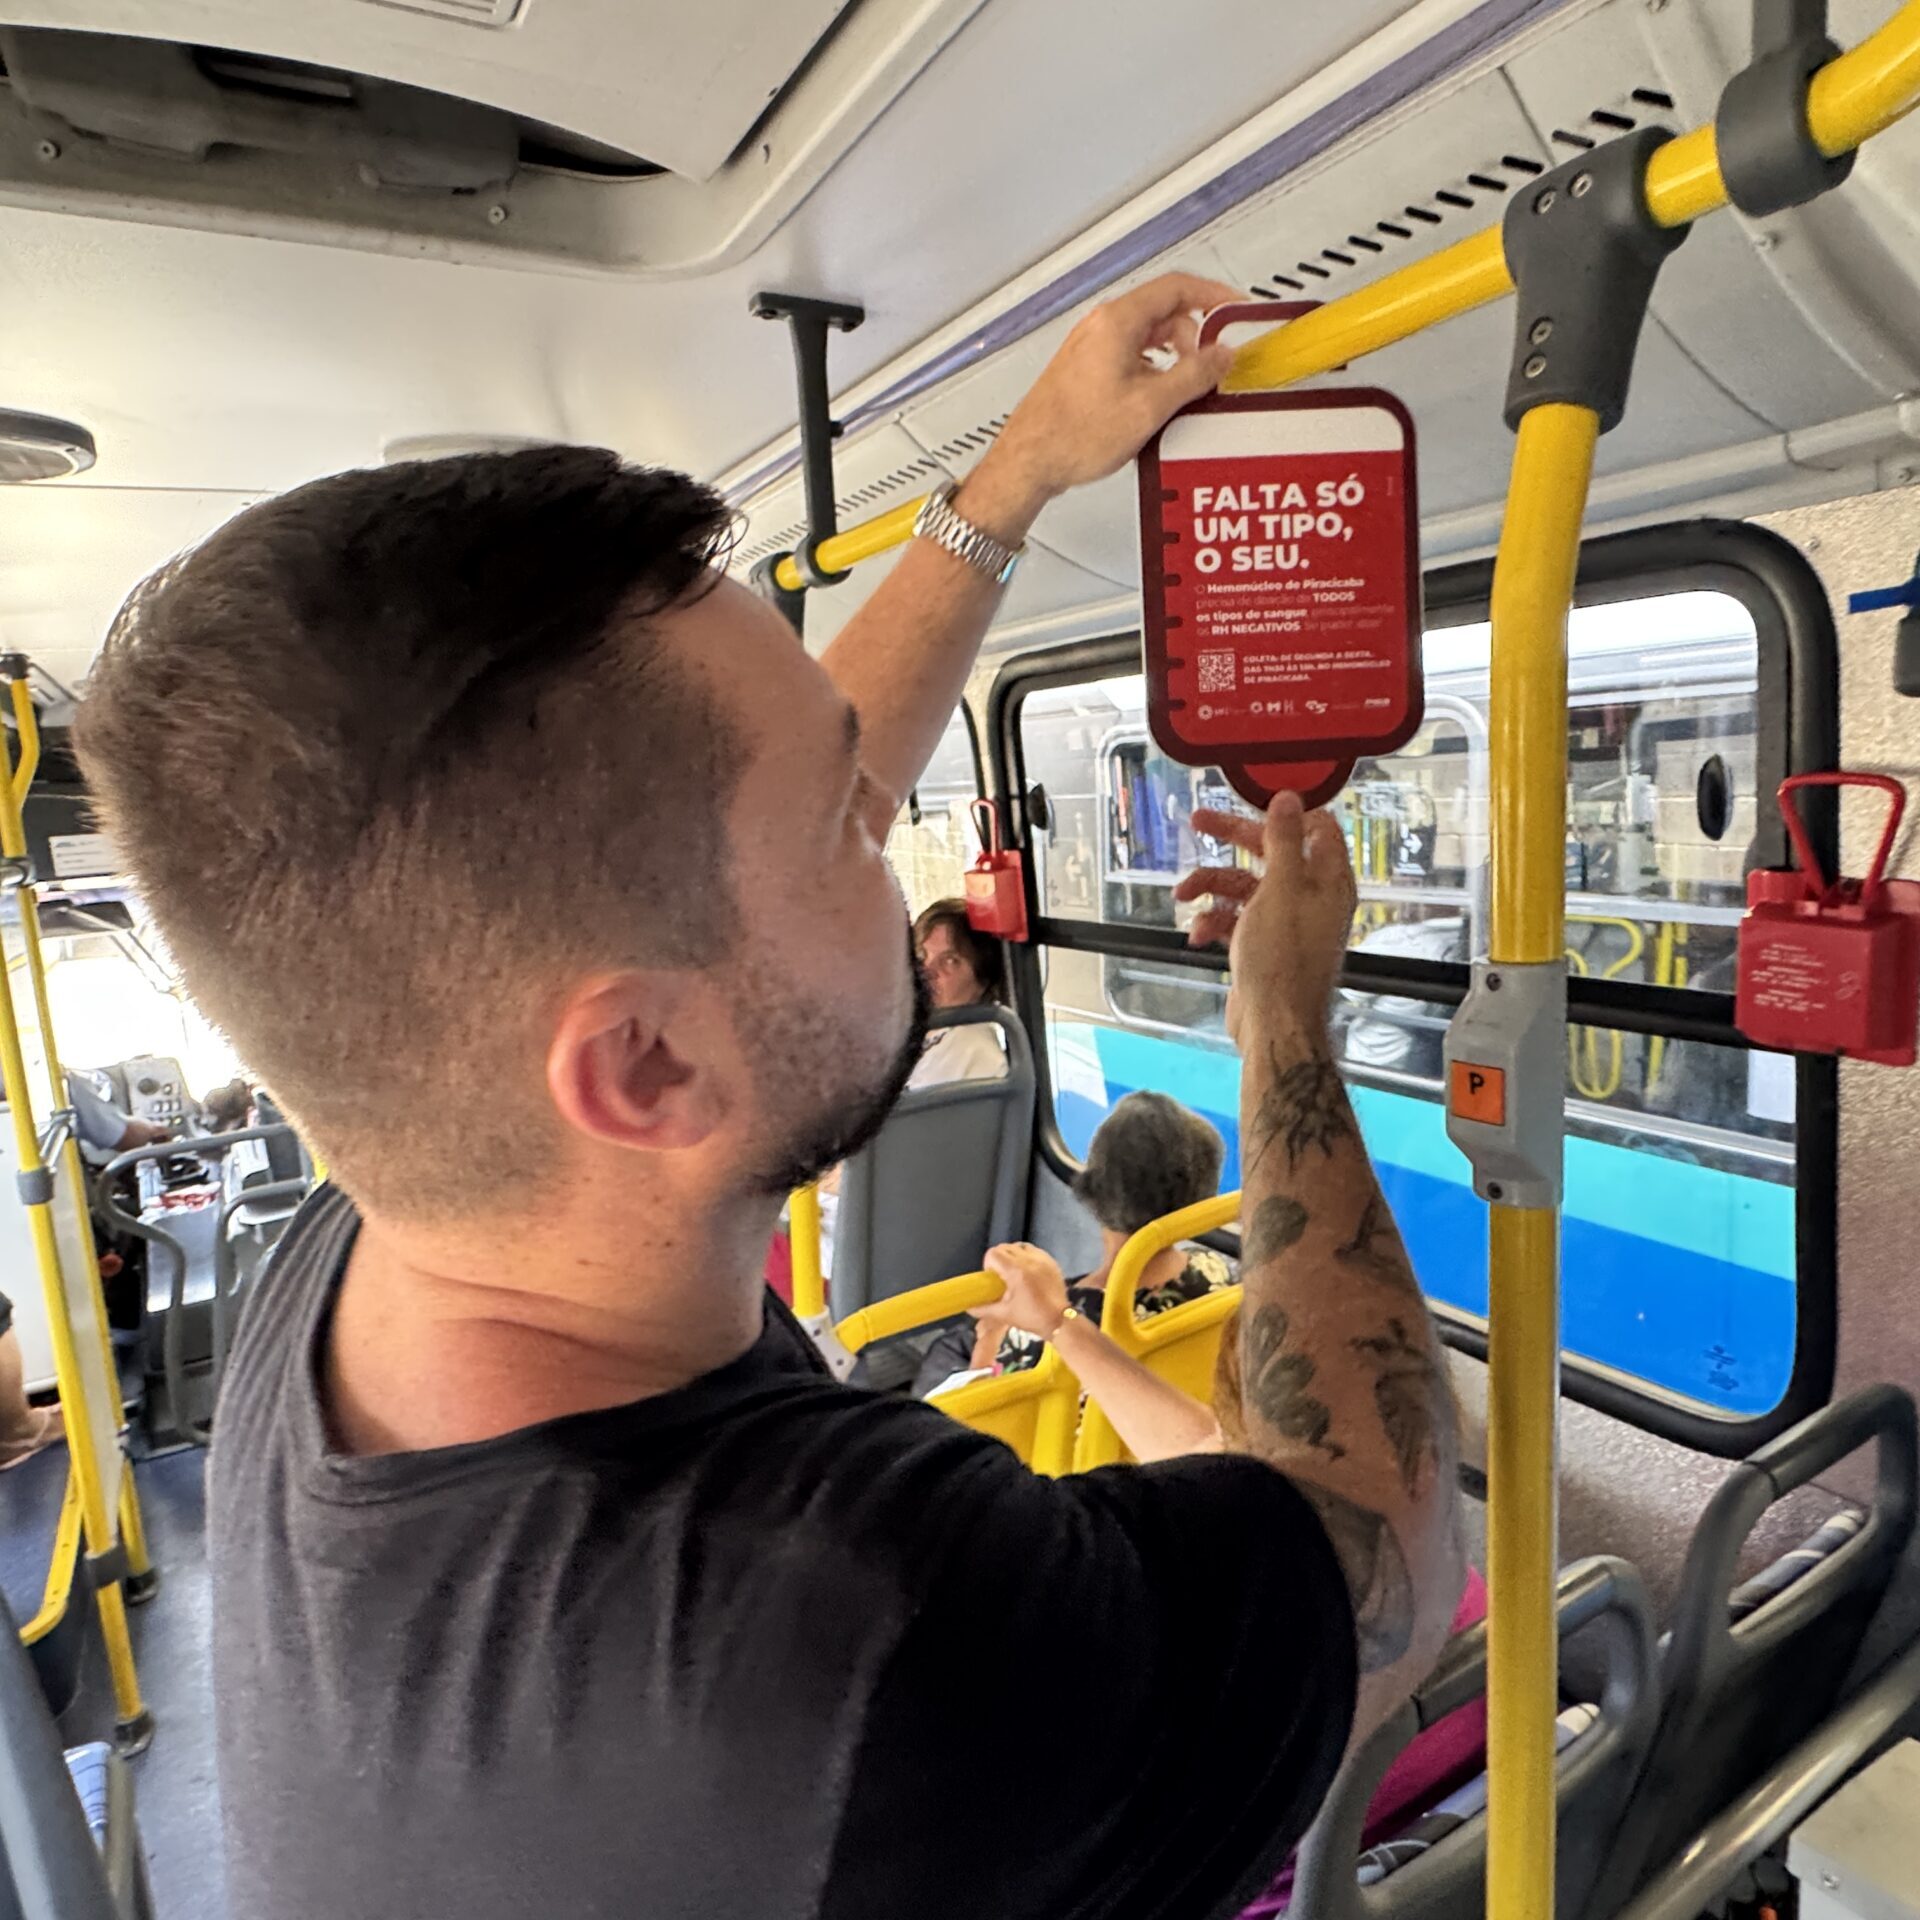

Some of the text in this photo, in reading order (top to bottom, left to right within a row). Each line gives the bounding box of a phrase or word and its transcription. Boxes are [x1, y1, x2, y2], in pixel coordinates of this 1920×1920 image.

[1193, 483, 1308, 513] FALTA
[1315, 473, 1365, 507] SÓ
[1194, 511, 1353, 543] UM TIPO,
[1194, 544, 1310, 573] O SEU.
[1207, 581, 1282, 593] Hemonúcleo
[1285, 580, 1300, 590] de
[1302, 577, 1365, 589] Piracicaba
[1313, 591, 1355, 603] TODOS
[1196, 613, 1210, 623] os
[1213, 610, 1243, 622] tipos
[1246, 609, 1260, 619] de
[1212, 625, 1229, 635] RH
[1280, 653, 1292, 662] DE
[1294, 652, 1334, 661] SEGUNDA
[1243, 665, 1262, 674] DAS
[1243, 676, 1256, 684] DE
[1468, 1072, 1485, 1095] P
